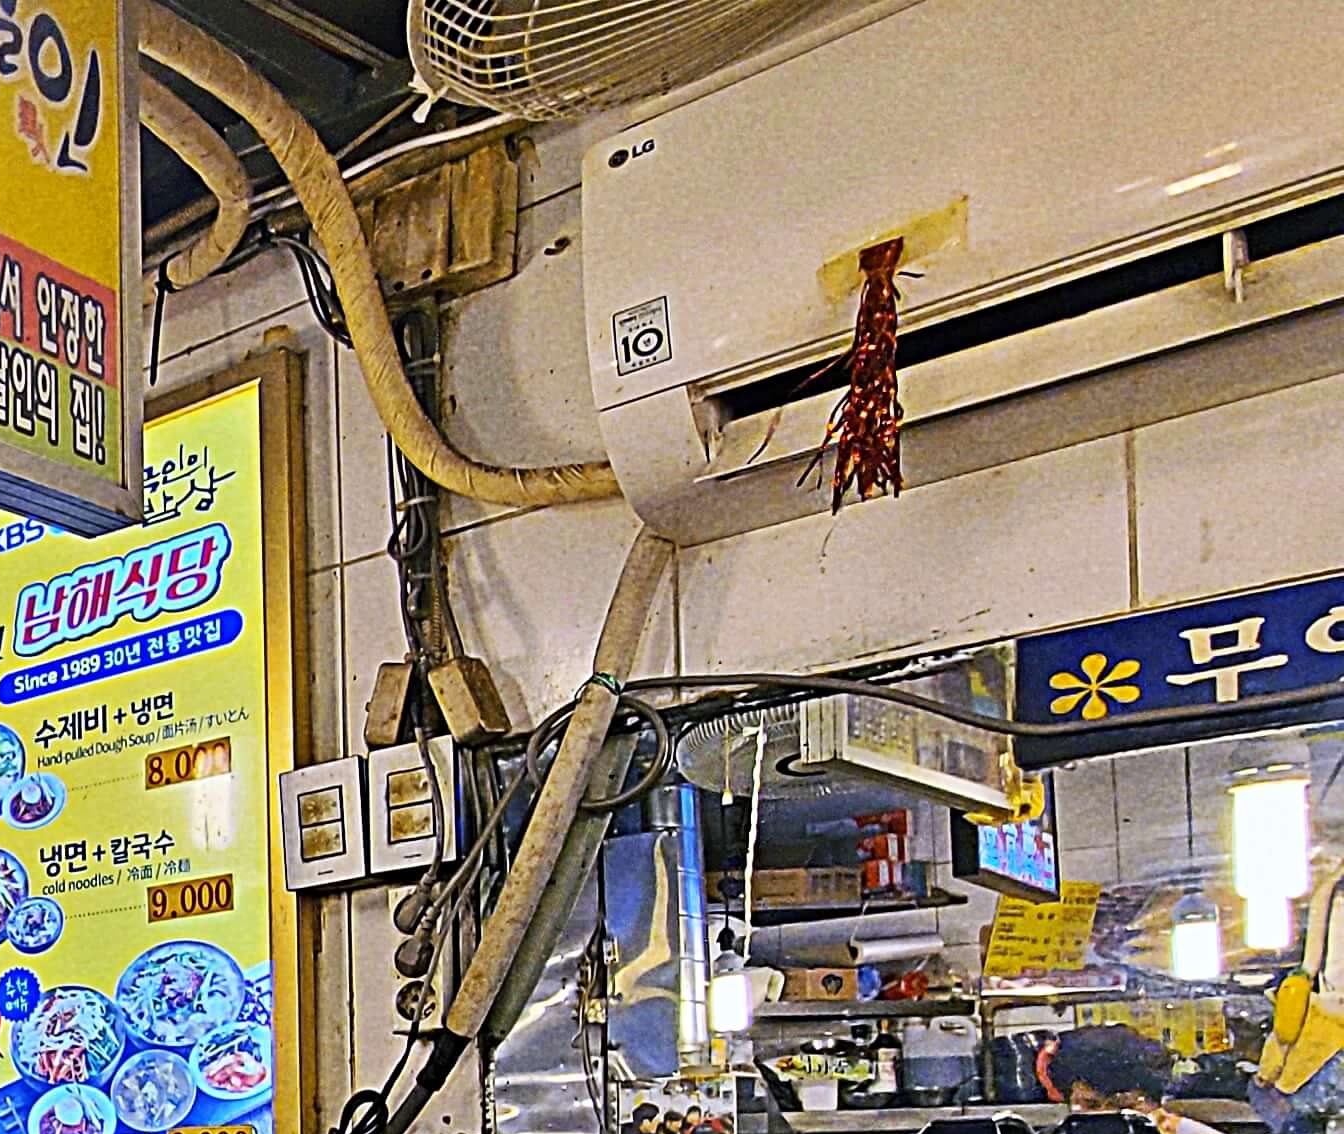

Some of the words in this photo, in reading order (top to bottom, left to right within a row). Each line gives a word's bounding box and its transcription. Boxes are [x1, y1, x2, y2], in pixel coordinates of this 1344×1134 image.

[632, 139, 655, 158] LG
[36, 276, 104, 376] 인정한
[621, 328, 664, 363] 10
[70, 384, 106, 465] 집!
[21, 535, 219, 646] 남해식당
[14, 662, 59, 694] Since
[62, 654, 101, 682] 1989
[104, 641, 142, 669] 30년
[147, 618, 222, 657] 전통맛집
[34, 704, 108, 749] 수제비
[130, 691, 175, 728] 냉면
[37, 744, 95, 769] Hand-pulled
[96, 734, 128, 754] Dough
[128, 730, 156, 748] Soup
[206, 706, 250, 728] すいとん
[40, 839, 88, 878] 냉면
[111, 829, 176, 865] 칼국수
[42, 881, 66, 896] cold
[68, 872, 115, 892] noodles
[151, 877, 233, 919] 9.000
